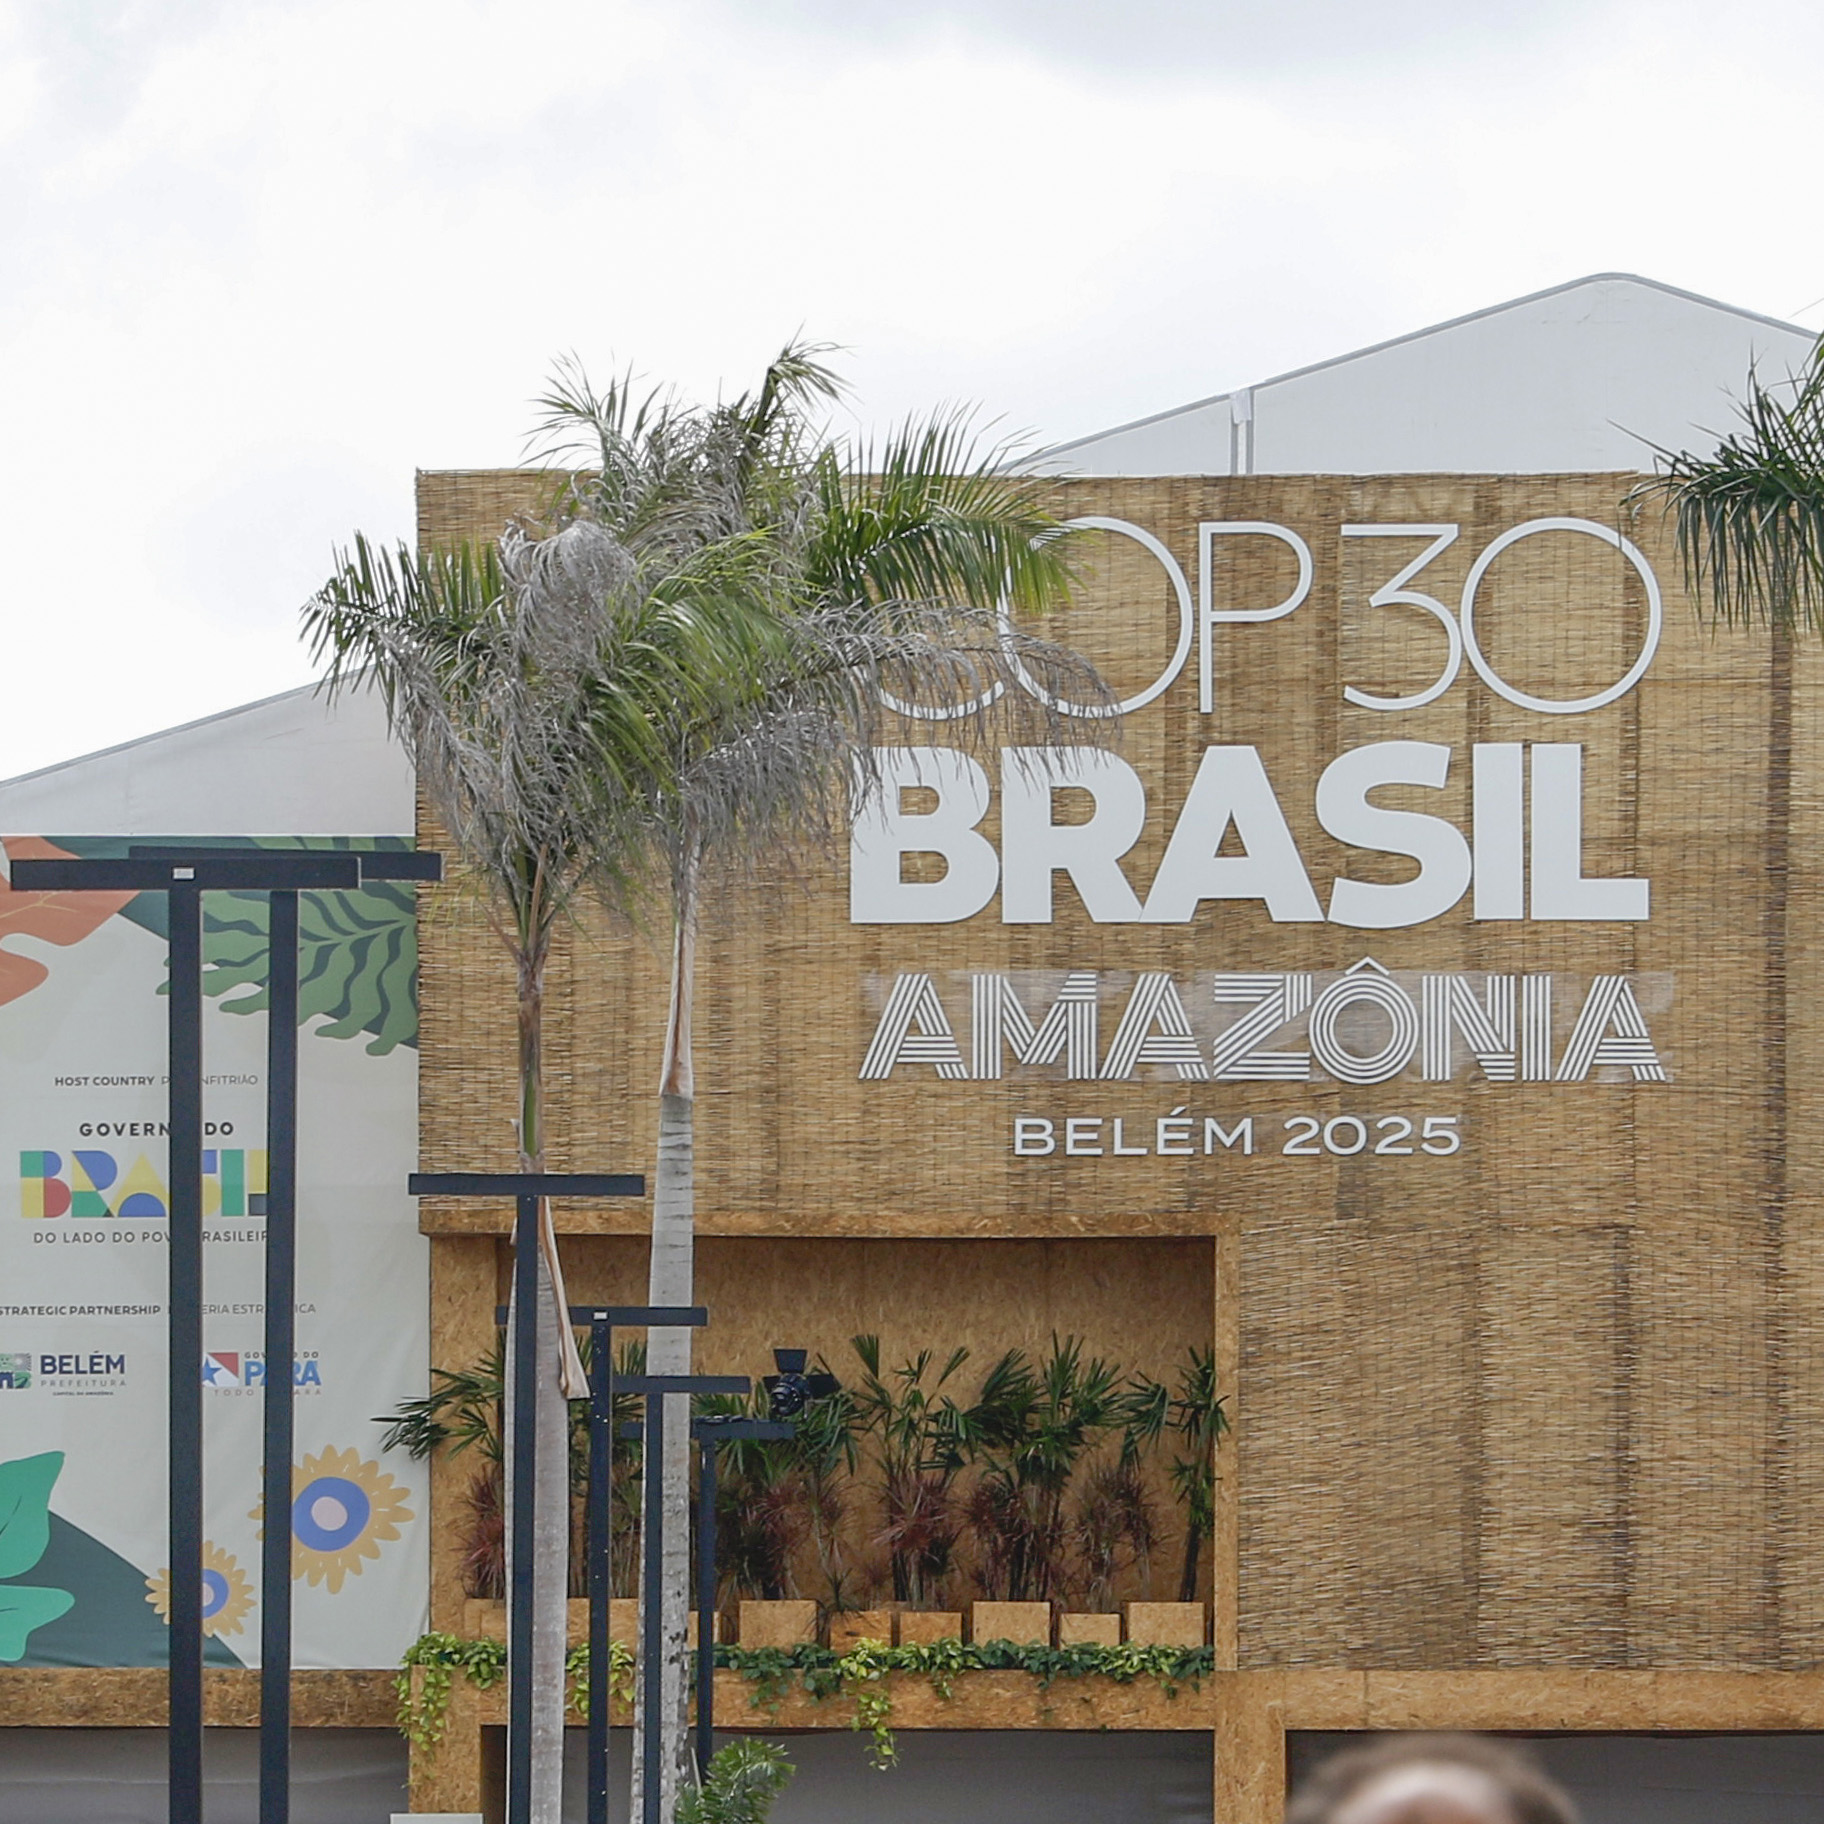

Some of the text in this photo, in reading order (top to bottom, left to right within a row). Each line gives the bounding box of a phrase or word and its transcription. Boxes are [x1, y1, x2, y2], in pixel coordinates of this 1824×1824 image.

[843, 515, 1314, 720] OP
[849, 740, 1651, 929] BRASIL
[858, 956, 1668, 1085] AMAZÔNIA
[54, 1076, 90, 1087] HOST
[92, 1075, 156, 1087] COUNTRY
[79, 1121, 234, 1137] GOVERN DO
[1012, 1105, 1463, 1158] BELÉM 2025
[33, 1230, 268, 1245] DO LADO DO POV RASILEIR
[69, 1304, 162, 1316] PARTNERSHIP
[39, 1350, 126, 1376] BELÉM
[40, 1379, 127, 1389] PREFEITURA
